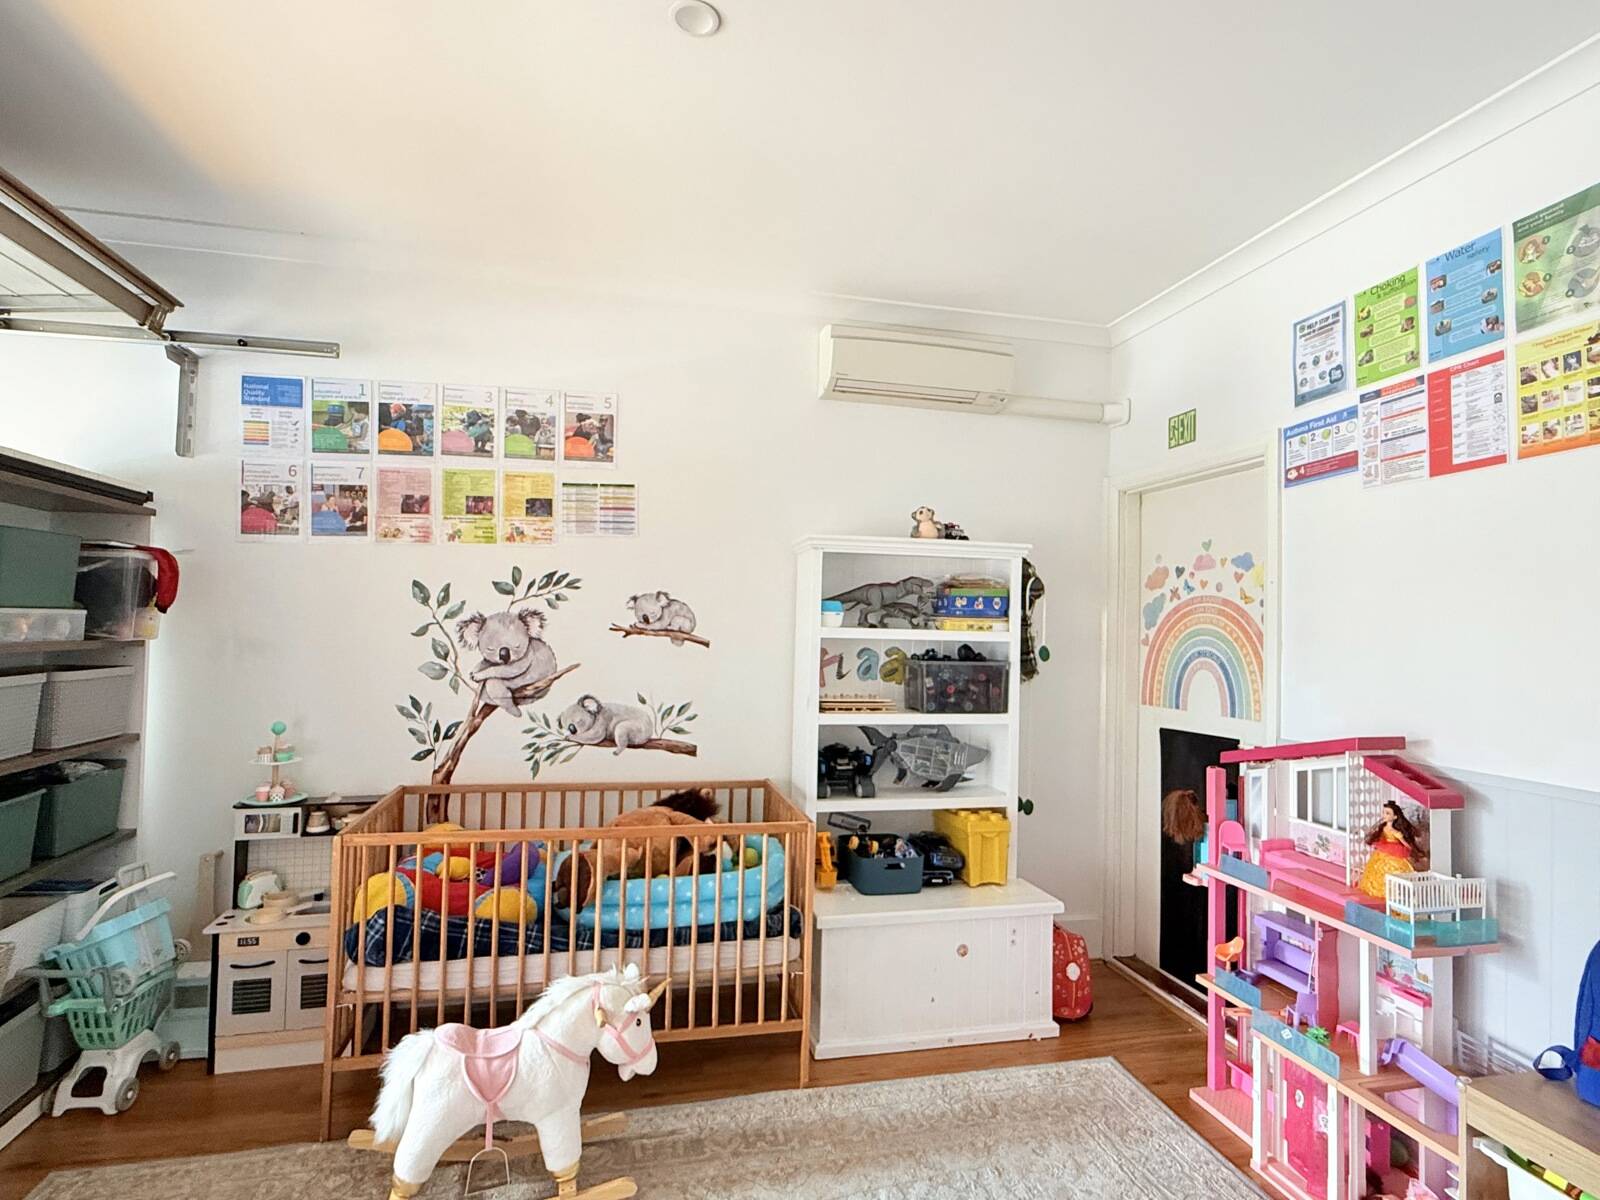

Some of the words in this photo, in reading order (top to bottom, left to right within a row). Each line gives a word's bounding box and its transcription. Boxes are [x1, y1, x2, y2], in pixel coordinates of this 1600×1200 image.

[1444, 241, 1477, 262] Water
[1370, 274, 1406, 296] Choking
[1306, 320, 1319, 331] HELP
[1318, 315, 1331, 326] STOP
[1331, 311, 1341, 320] THE
[358, 383, 367, 397] 1
[423, 387, 432, 399] 2
[484, 391, 494, 403] 3
[544, 394, 554, 408] 4
[603, 396, 613, 410] 5
[1179, 411, 1195, 445] EXIT
[1309, 419, 1325, 430] First
[1325, 414, 1338, 425] Aid
[1310, 432, 1317, 442] 2
[1334, 425, 1341, 435] 3
[288, 464, 298, 478] 6
[355, 466, 365, 480] 7
[1299, 466, 1305, 475] 4
